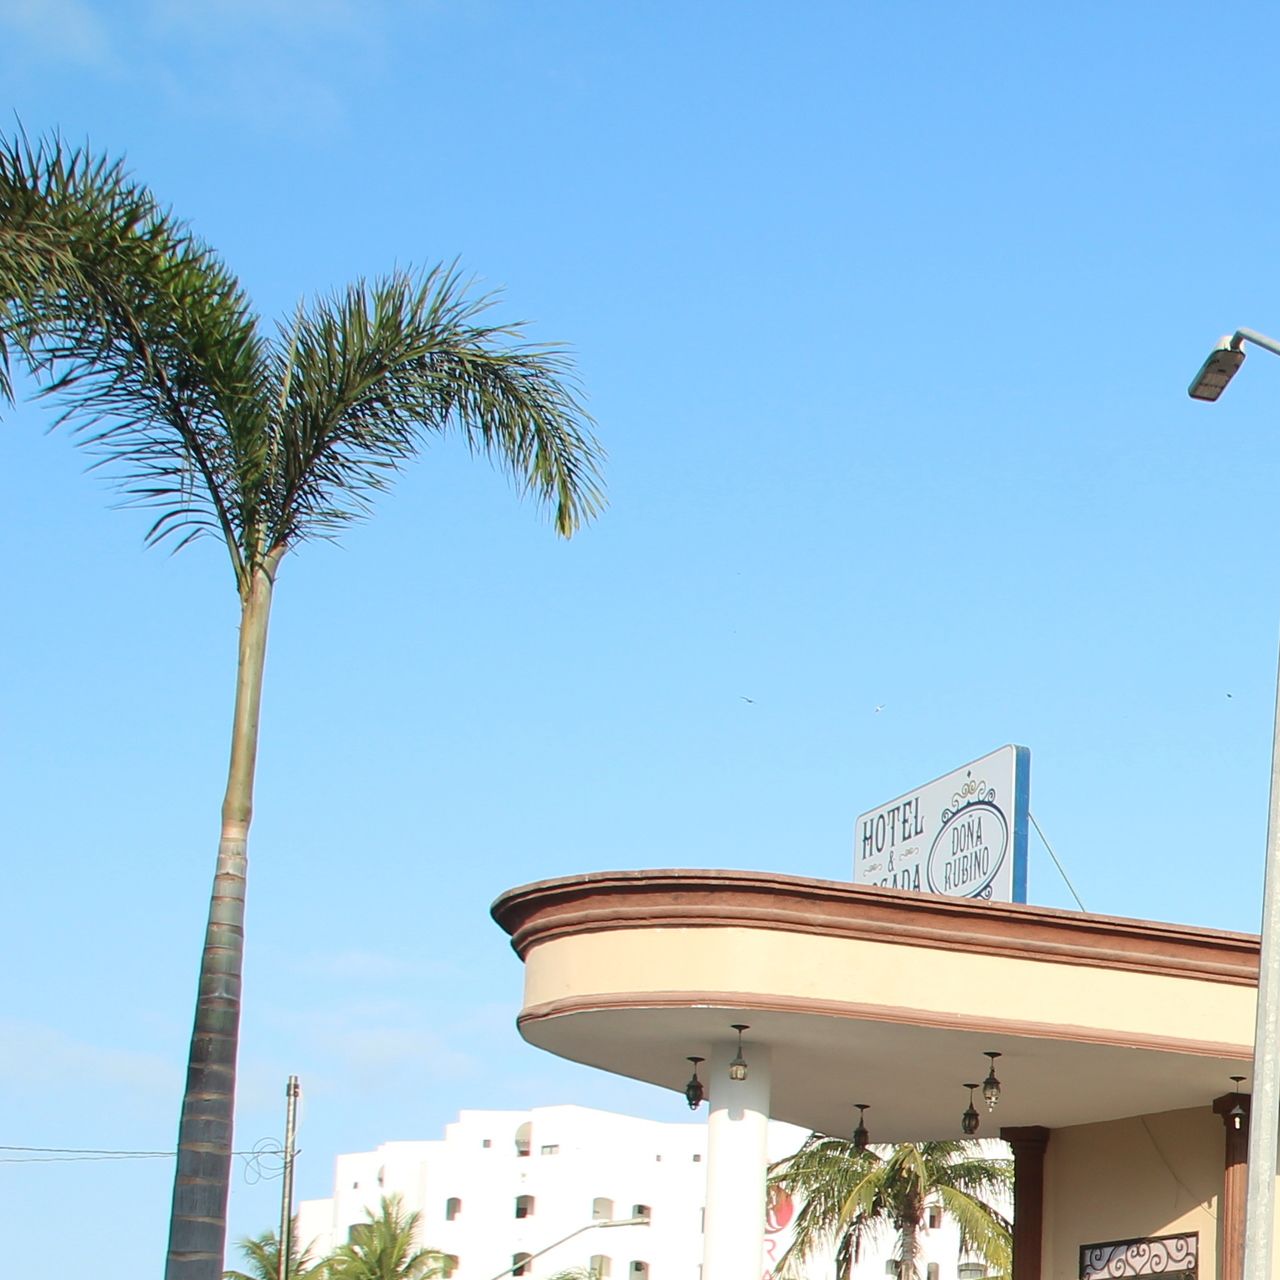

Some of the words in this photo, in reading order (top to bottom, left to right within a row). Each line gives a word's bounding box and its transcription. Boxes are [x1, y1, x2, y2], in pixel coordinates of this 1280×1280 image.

[862, 797, 924, 860] HOTEL
[952, 814, 982, 857] DOÑA
[888, 850, 894, 873] &
[944, 846, 989, 892] RUBINO
